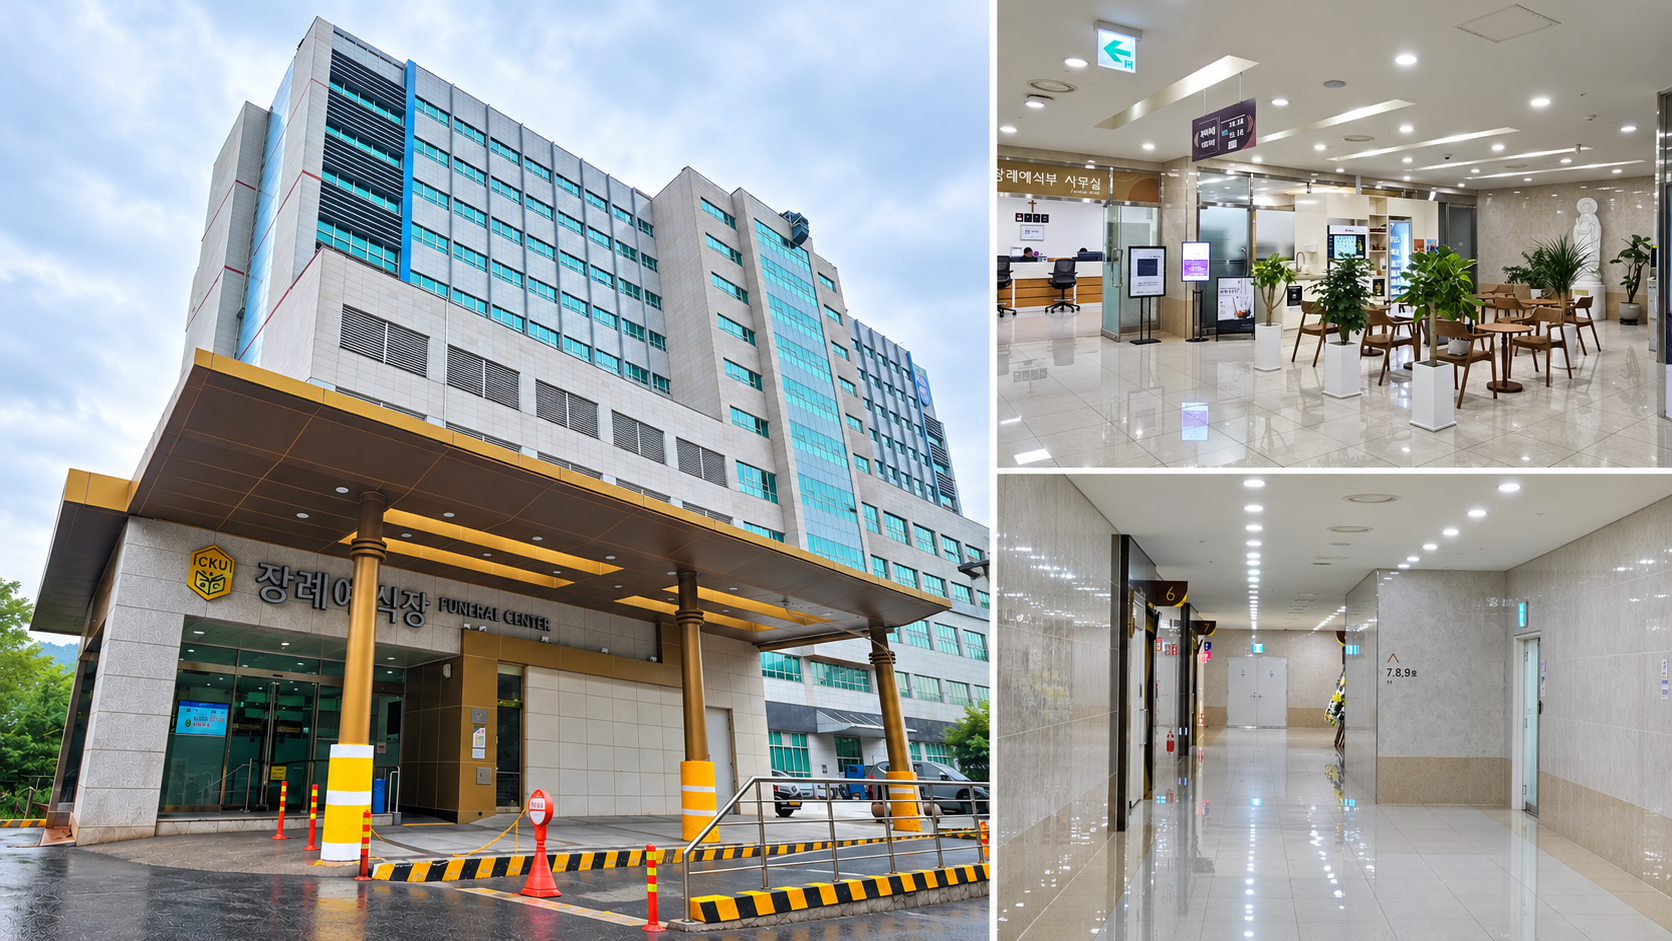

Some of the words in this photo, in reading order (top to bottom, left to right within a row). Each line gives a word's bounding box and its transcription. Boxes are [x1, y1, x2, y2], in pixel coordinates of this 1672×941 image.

[1064, 175, 1101, 191] 사무실
[198, 556, 228, 571] CKU
[1166, 586, 1176, 602] 6
[438, 597, 501, 622] FUNERAL
[503, 609, 552, 632] CENTER
[1204, 623, 1211, 634] 7
